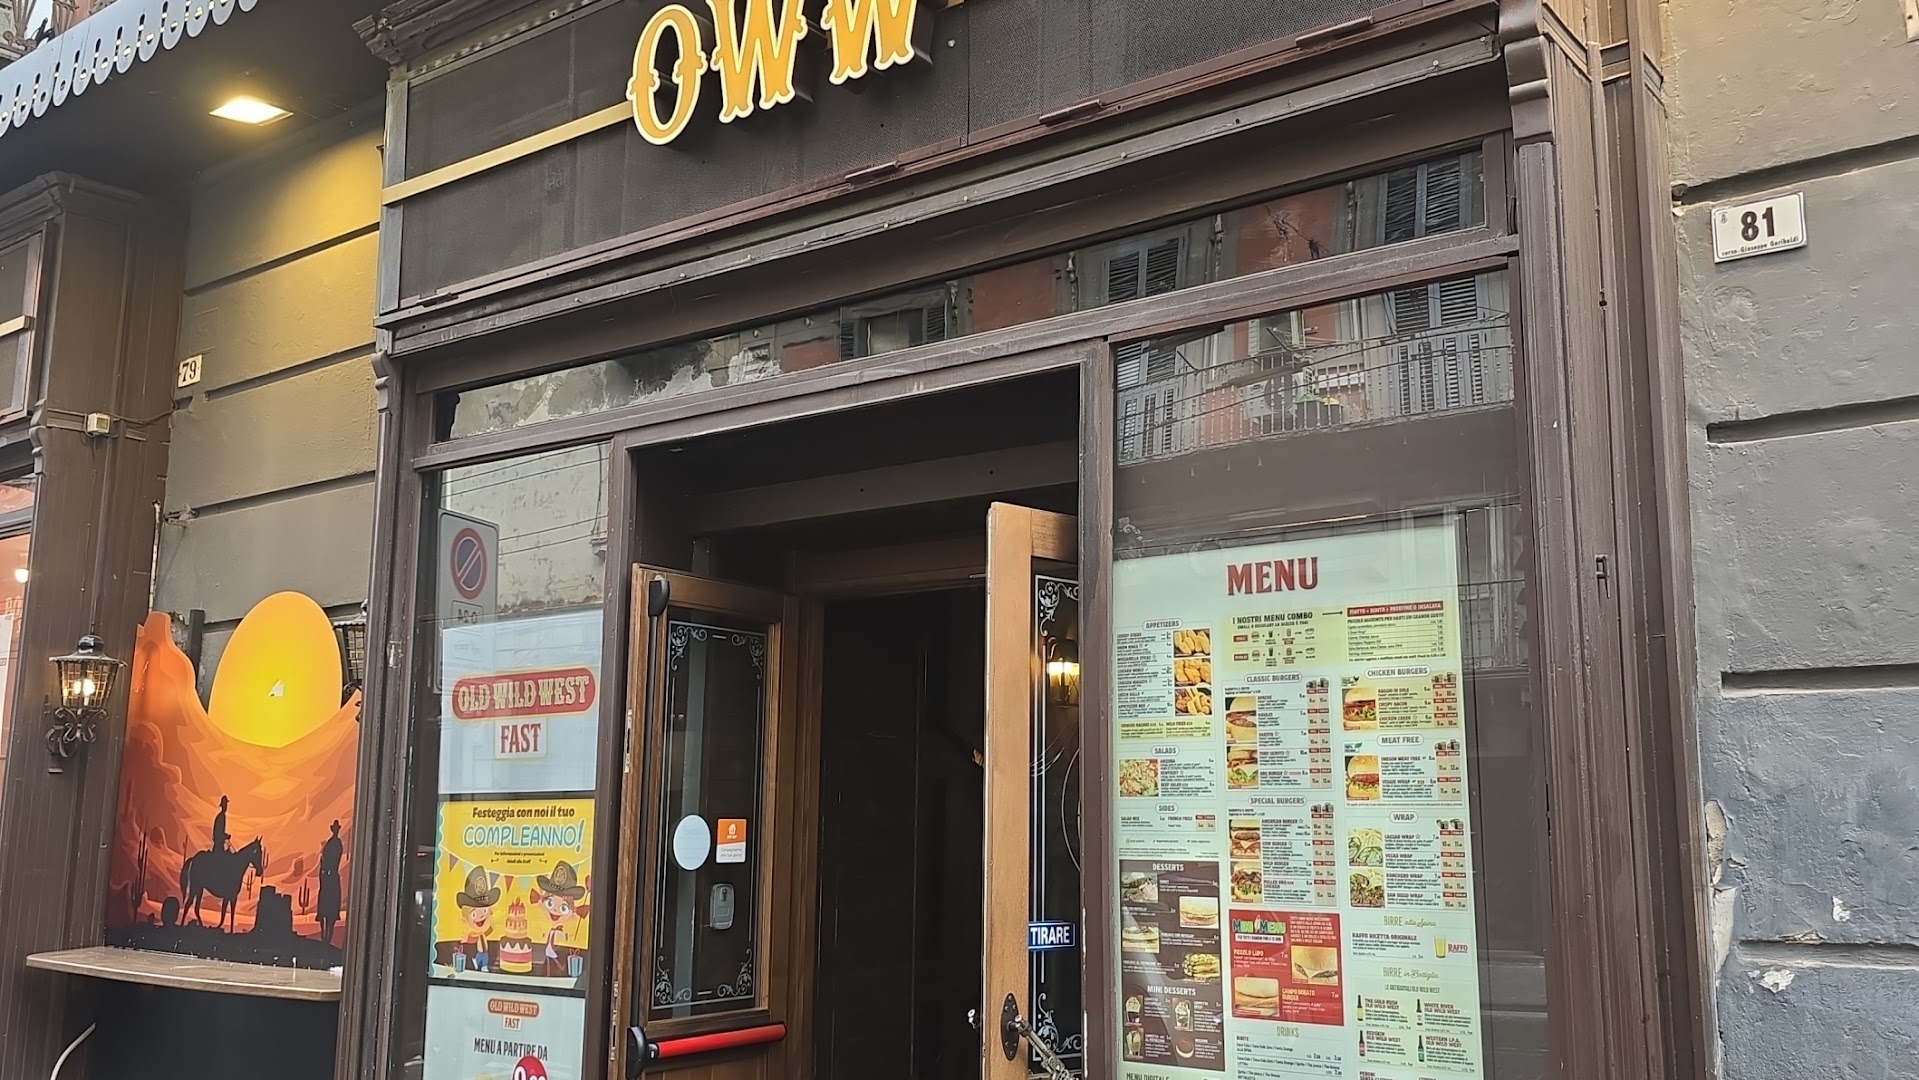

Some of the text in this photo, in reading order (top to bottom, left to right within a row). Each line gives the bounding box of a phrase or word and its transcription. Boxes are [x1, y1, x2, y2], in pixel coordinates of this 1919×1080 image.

[626, 0, 916, 145] OWW
[1740, 206, 1775, 241] 81
[1741, 243, 1767, 253] Giuseppe
[1770, 236, 1799, 247] Garibaldi
[182, 360, 197, 382] 79
[1227, 557, 1318, 596] MENU
[1146, 620, 1179, 629] APPETIZERS
[1237, 616, 1262, 624] NOSTRI
[1287, 612, 1312, 620] COMBO
[458, 676, 590, 712] OLD WILD WEST
[500, 723, 542, 754] FAST
[472, 806, 575, 821] Festeggia con noi il tuo
[464, 819, 585, 852] COMPLEANNO!
[1384, 916, 1402, 926] BIRRE
[1030, 926, 1070, 945] TIRARE
[1448, 943, 1468, 952] RAFFO
[1383, 967, 1402, 977] BIRRE
[1147, 985, 1196, 996] MINI DESSERTS
[490, 1001, 537, 1015] OLD WILD WEST
[505, 1018, 520, 1029] FAST
[1277, 1026, 1299, 1037] DRINKS
[474, 1038, 548, 1061] MENU A PARTIRE DA
